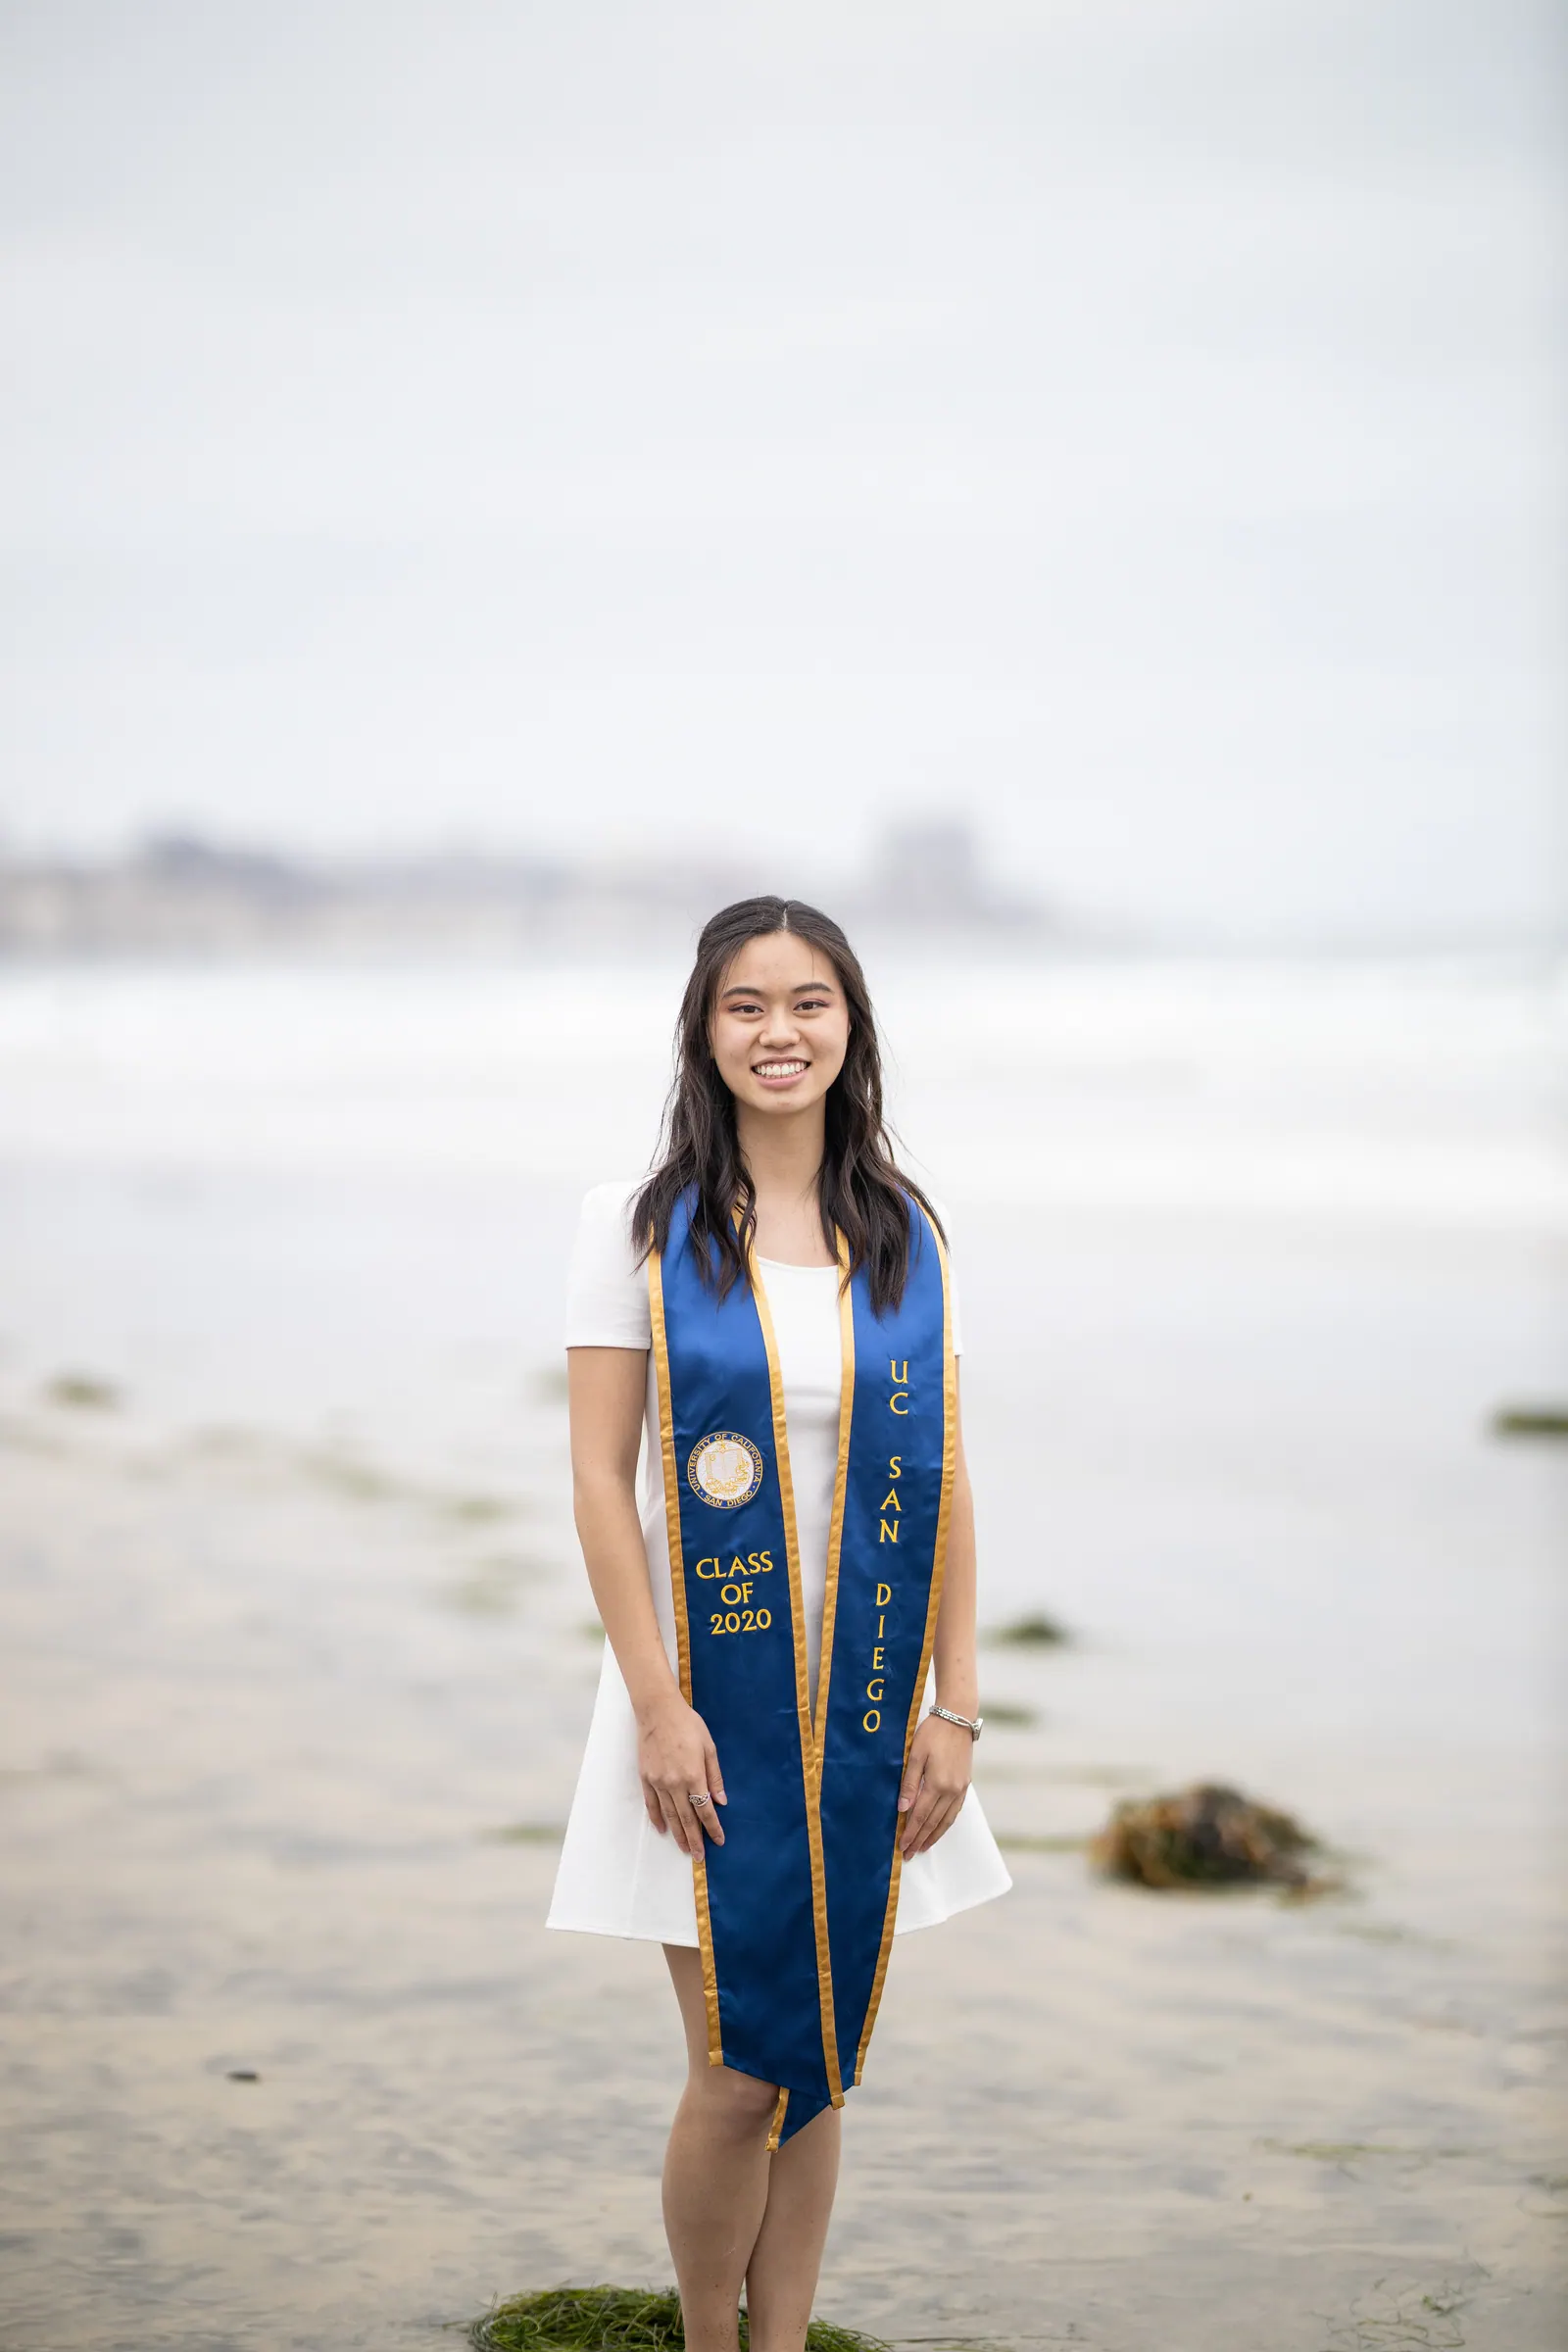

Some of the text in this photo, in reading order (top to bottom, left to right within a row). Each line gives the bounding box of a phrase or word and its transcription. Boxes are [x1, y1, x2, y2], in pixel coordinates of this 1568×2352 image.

[689, 1438, 710, 1491] UNIVERSITY
[731, 1435, 761, 1483] CALIFORNIA
[704, 1490, 753, 1506] SAN DIEGO
[862, 1359, 908, 1734] UC SAN DIEGO
[695, 1550, 774, 1580] CLASS
[720, 1582, 754, 1605] OF
[710, 1608, 772, 1636] 2020
